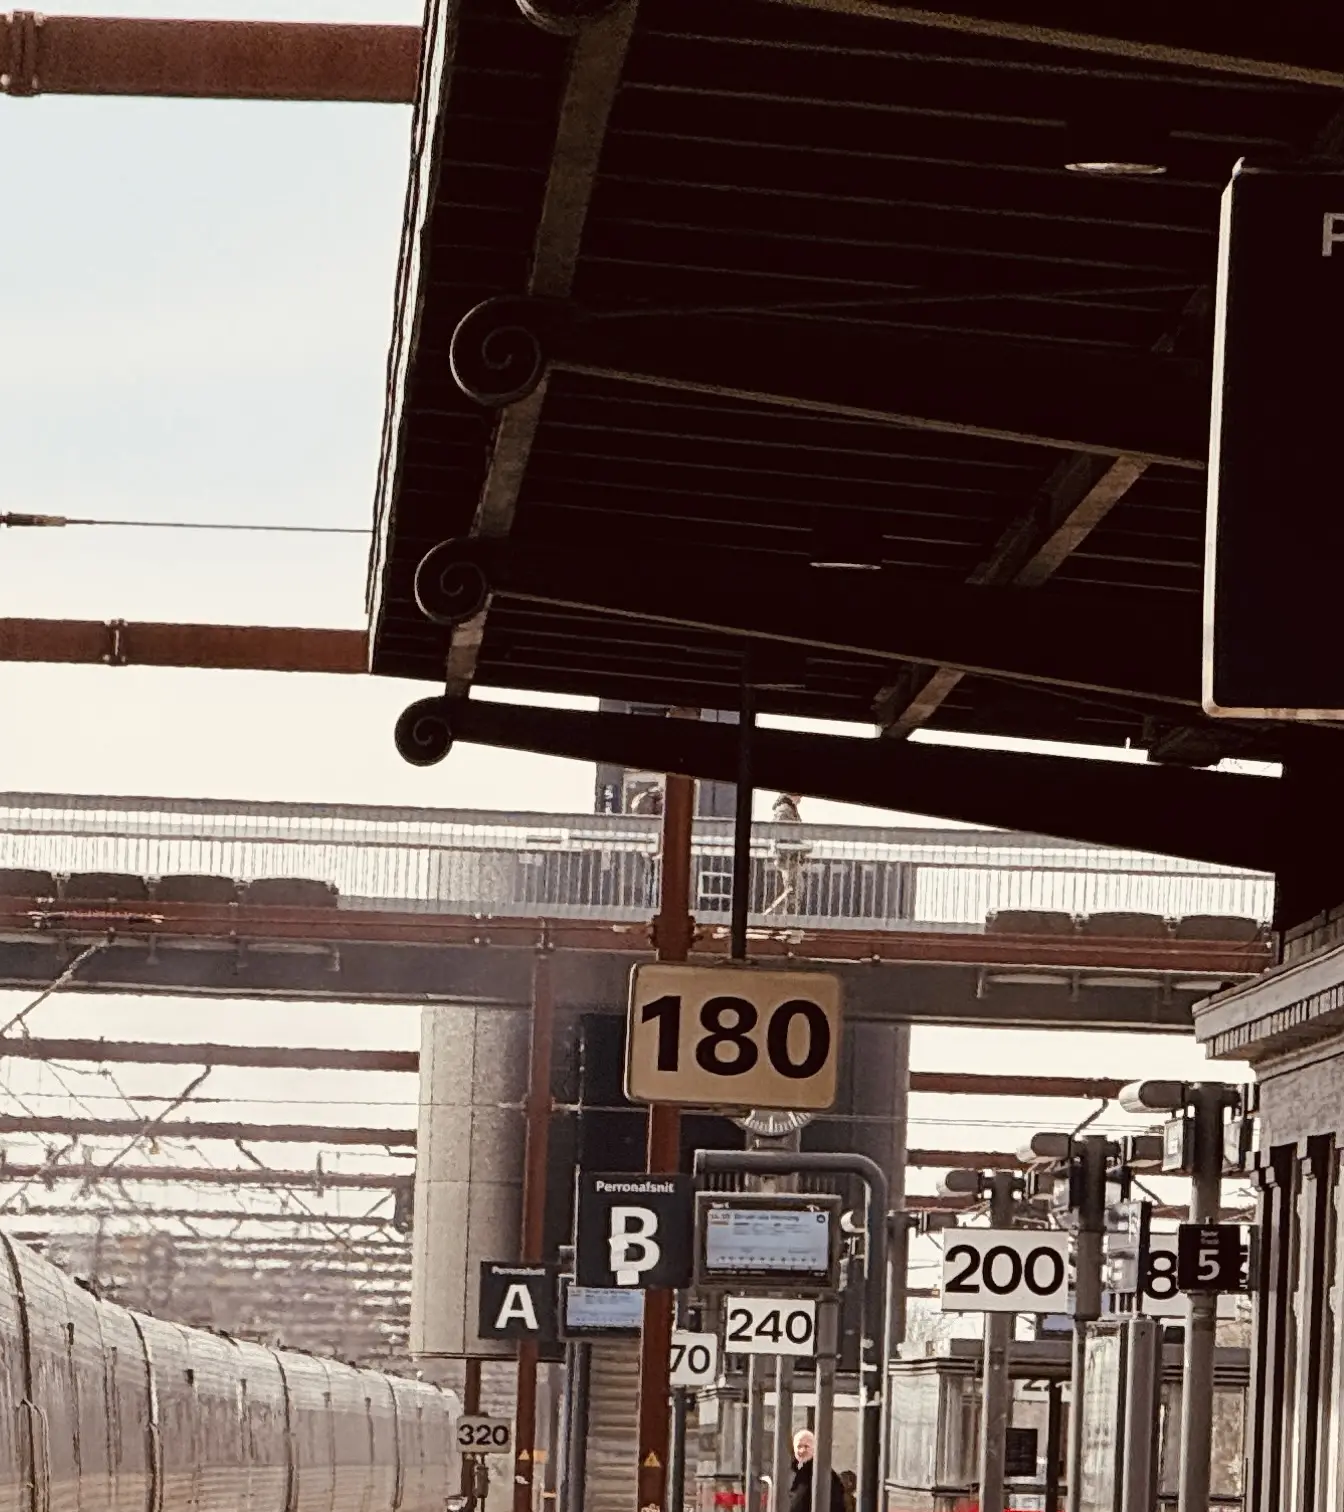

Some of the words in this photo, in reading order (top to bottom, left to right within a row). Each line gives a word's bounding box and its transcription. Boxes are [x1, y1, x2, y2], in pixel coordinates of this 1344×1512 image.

[641, 995, 831, 1079] 180
[596, 1180, 674, 1193] Perronafsnit
[610, 1206, 660, 1273] B
[944, 1244, 1064, 1296] 200
[1197, 1249, 1221, 1280] 5
[495, 1284, 539, 1330] A
[728, 1308, 812, 1344] 240
[458, 1424, 509, 1446] 320
